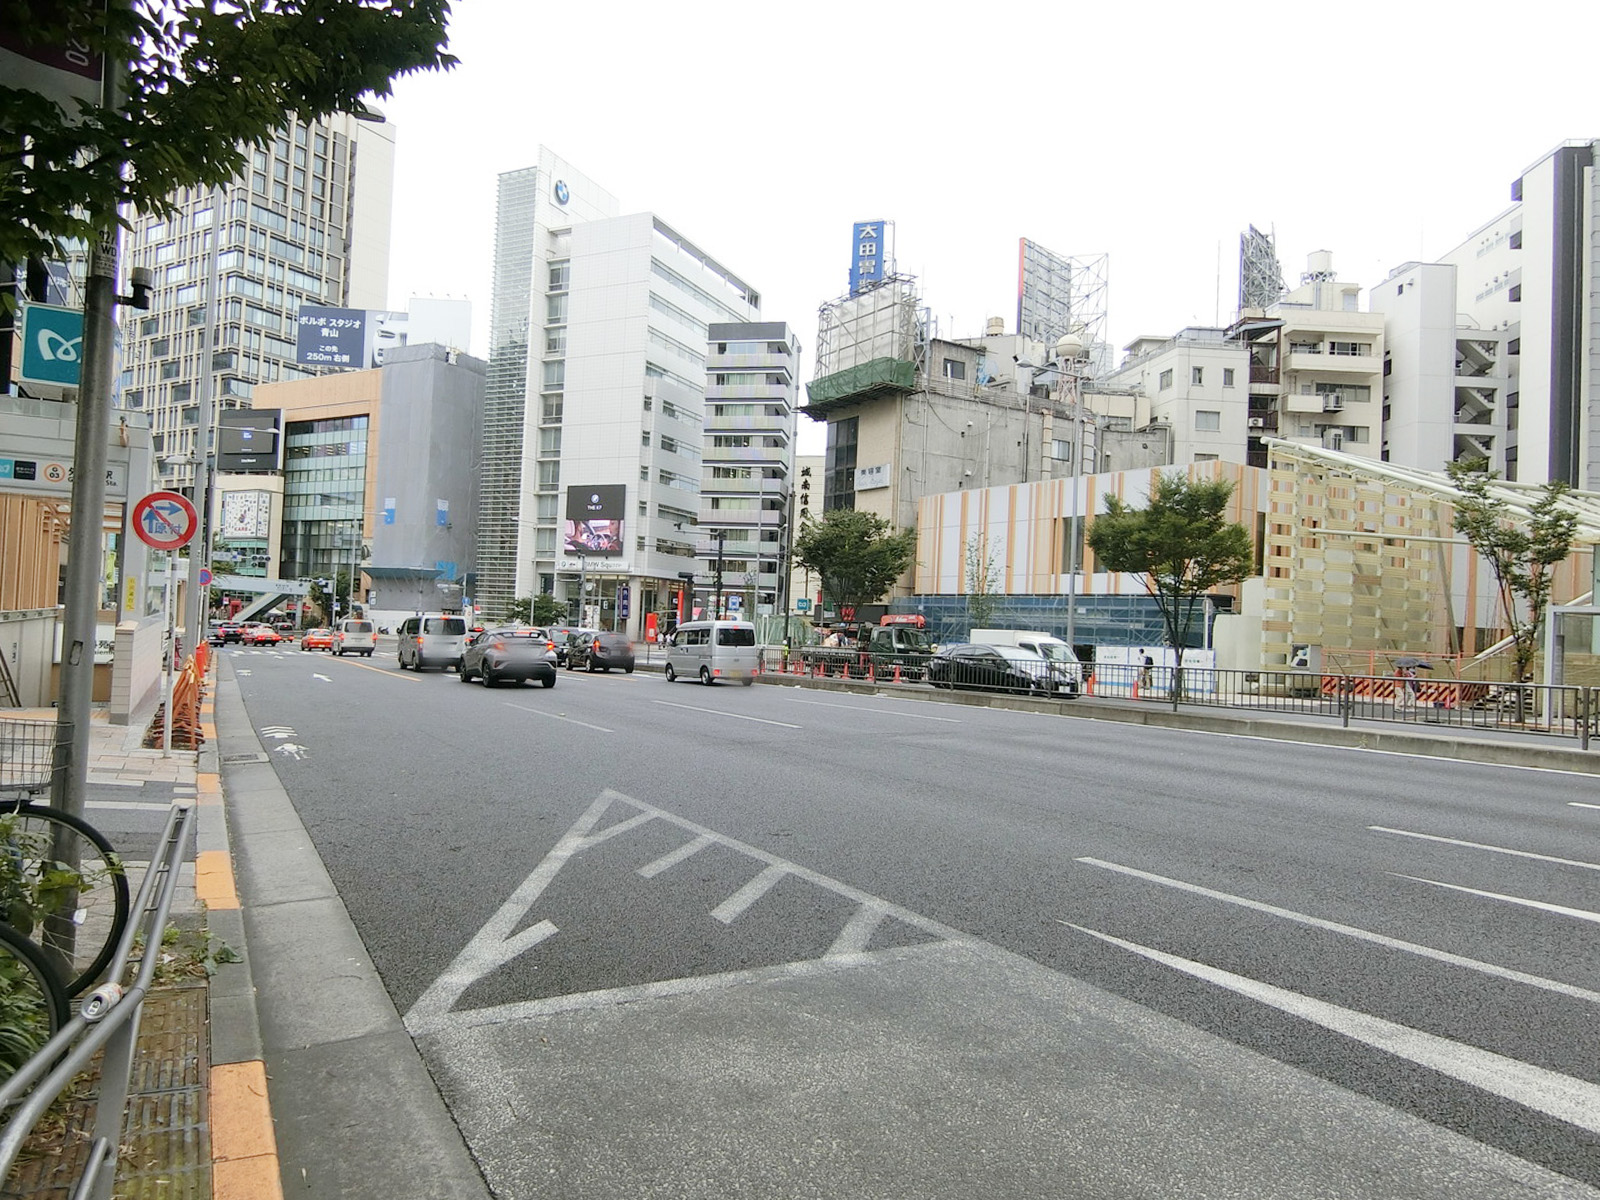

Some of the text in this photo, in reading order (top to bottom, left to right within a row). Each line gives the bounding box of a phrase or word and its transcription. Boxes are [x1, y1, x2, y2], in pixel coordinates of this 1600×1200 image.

[299, 316, 361, 329] ボルボ スタジオ
[321, 328, 339, 338] 青山
[319, 345, 338, 353] この先
[306, 352, 350, 363] 250m 右側
[155, 522, 182, 536] 原付
